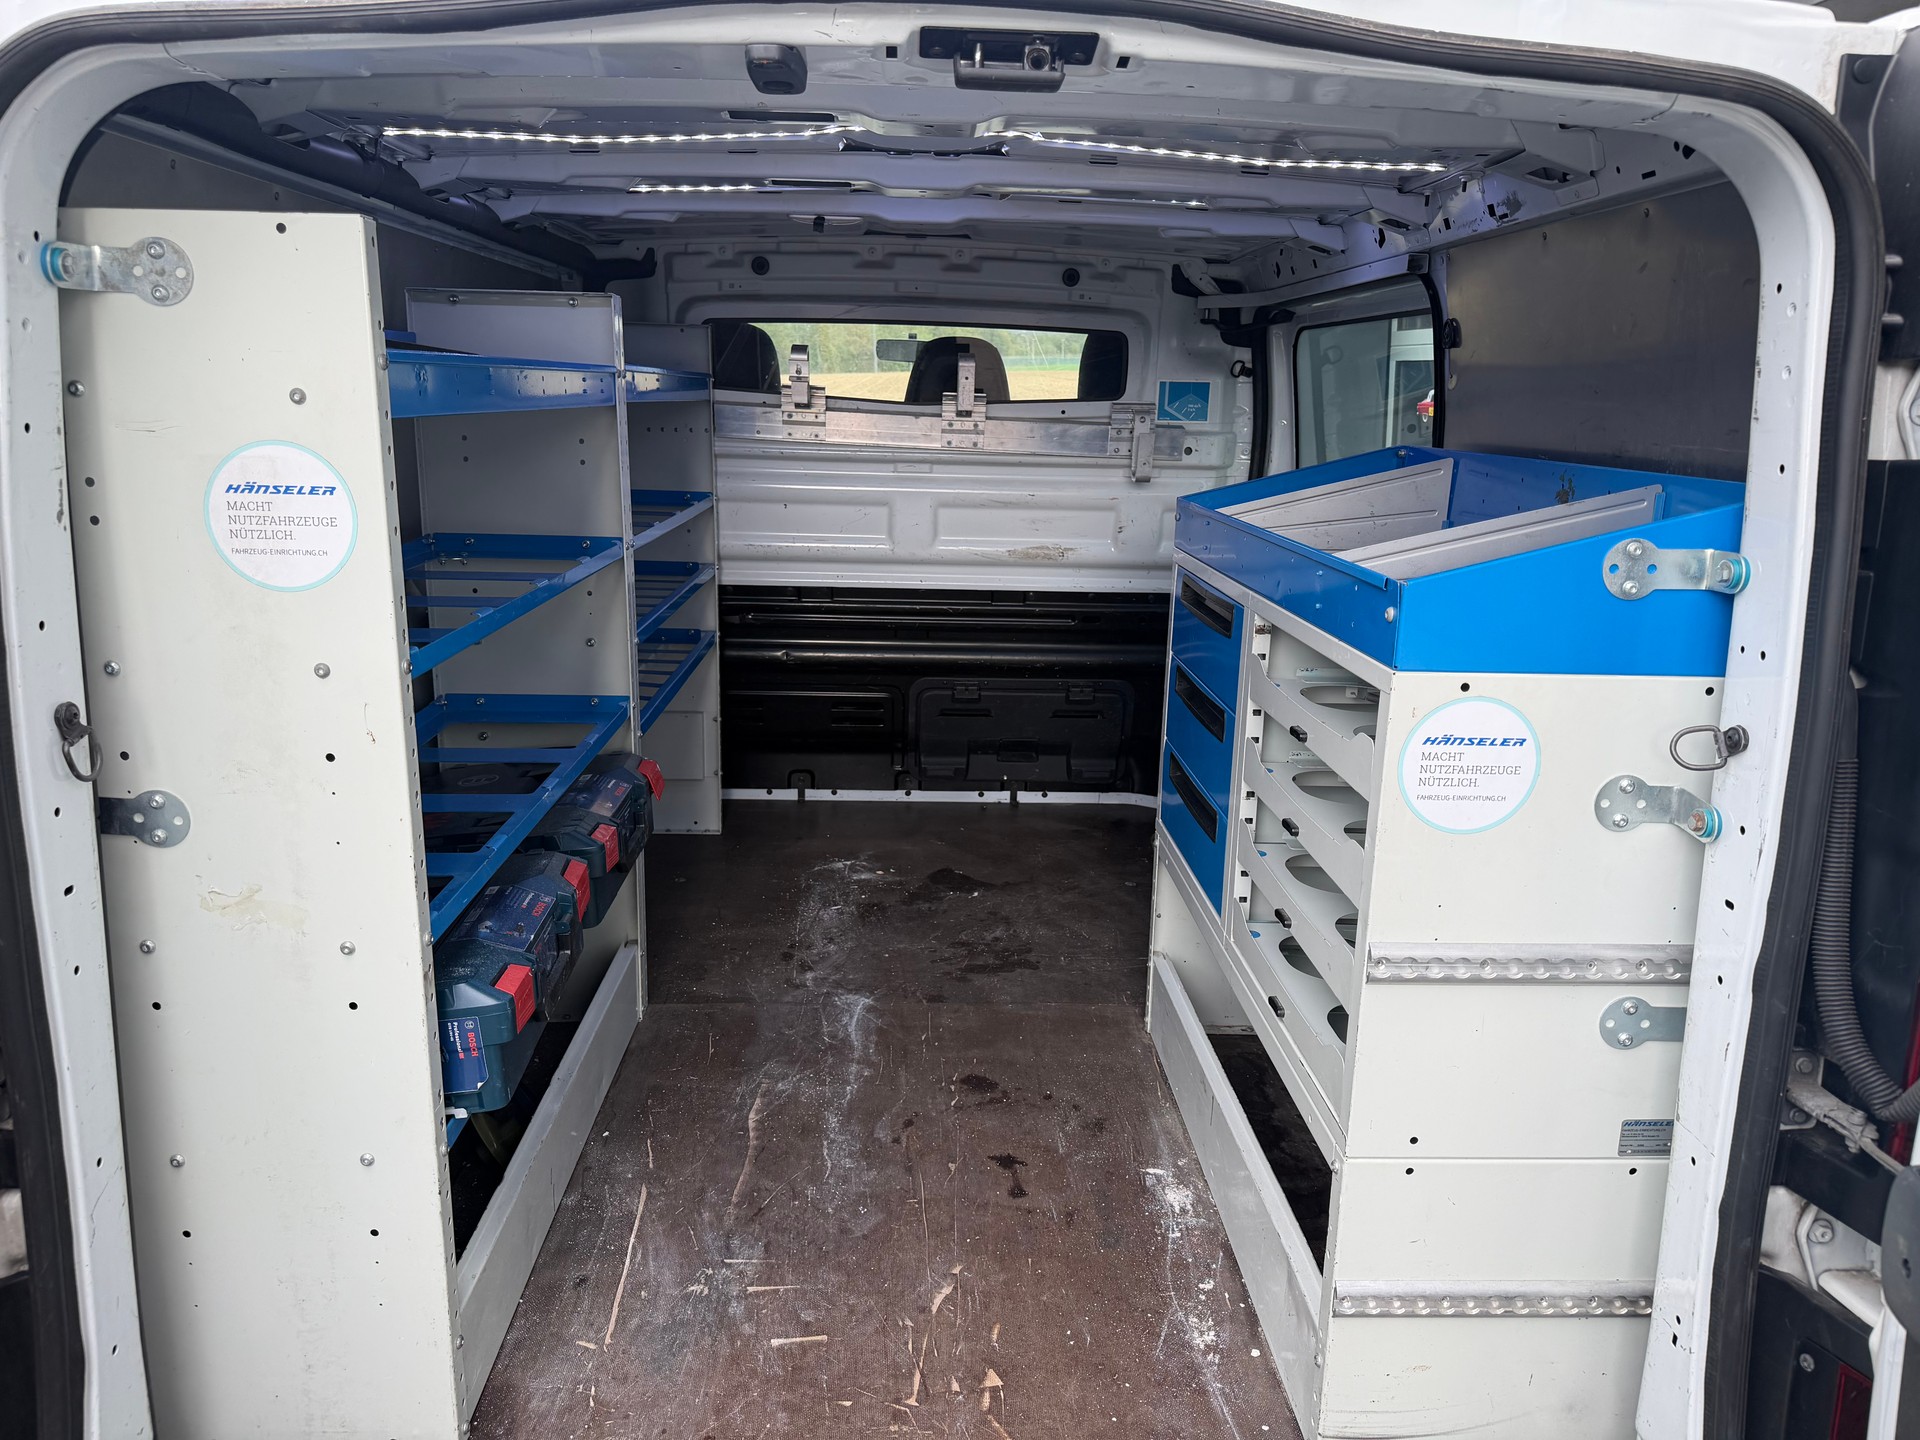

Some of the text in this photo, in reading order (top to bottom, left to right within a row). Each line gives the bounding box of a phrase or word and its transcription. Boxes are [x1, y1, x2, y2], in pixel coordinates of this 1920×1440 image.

[225, 481, 337, 496] HÄNSELER
[226, 500, 273, 512] MACHT
[228, 514, 338, 528] NUTZFAHRZEUGE
[229, 527, 297, 541] NÜTZLICH.
[231, 547, 328, 557] FAHRZEUG-EINRICHTUNG.CH
[1422, 734, 1527, 747] HÄNSELER
[1420, 751, 1465, 762] MACHT
[1419, 764, 1522, 775] NUTZFAHRZEUGE
[1418, 775, 1480, 788] NÜTZLICH.
[1416, 794, 1507, 802] FAHRZEUG-EINRICHTUNG.CH
[452, 1021, 463, 1053] Professional
[467, 1031, 479, 1057] BOSCH
